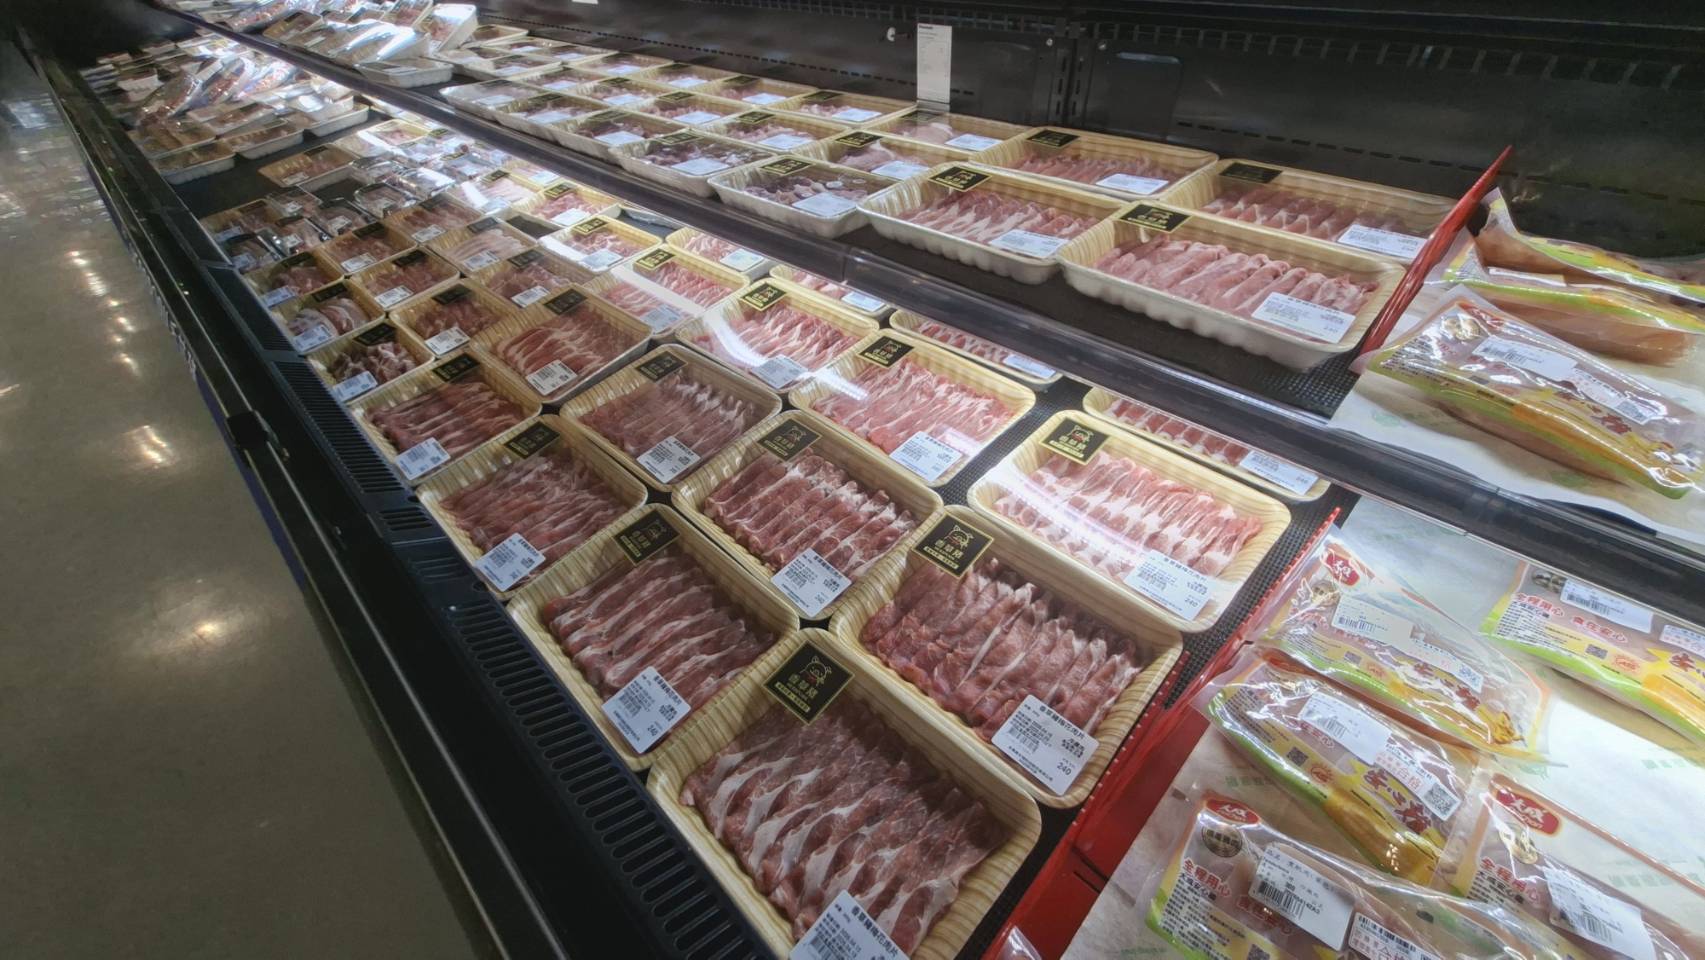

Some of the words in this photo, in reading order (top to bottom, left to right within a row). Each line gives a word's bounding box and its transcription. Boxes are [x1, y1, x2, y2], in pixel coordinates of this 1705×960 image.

[1057, 761, 1072, 776] 240
[1183, 857, 1232, 898] 全程用心
